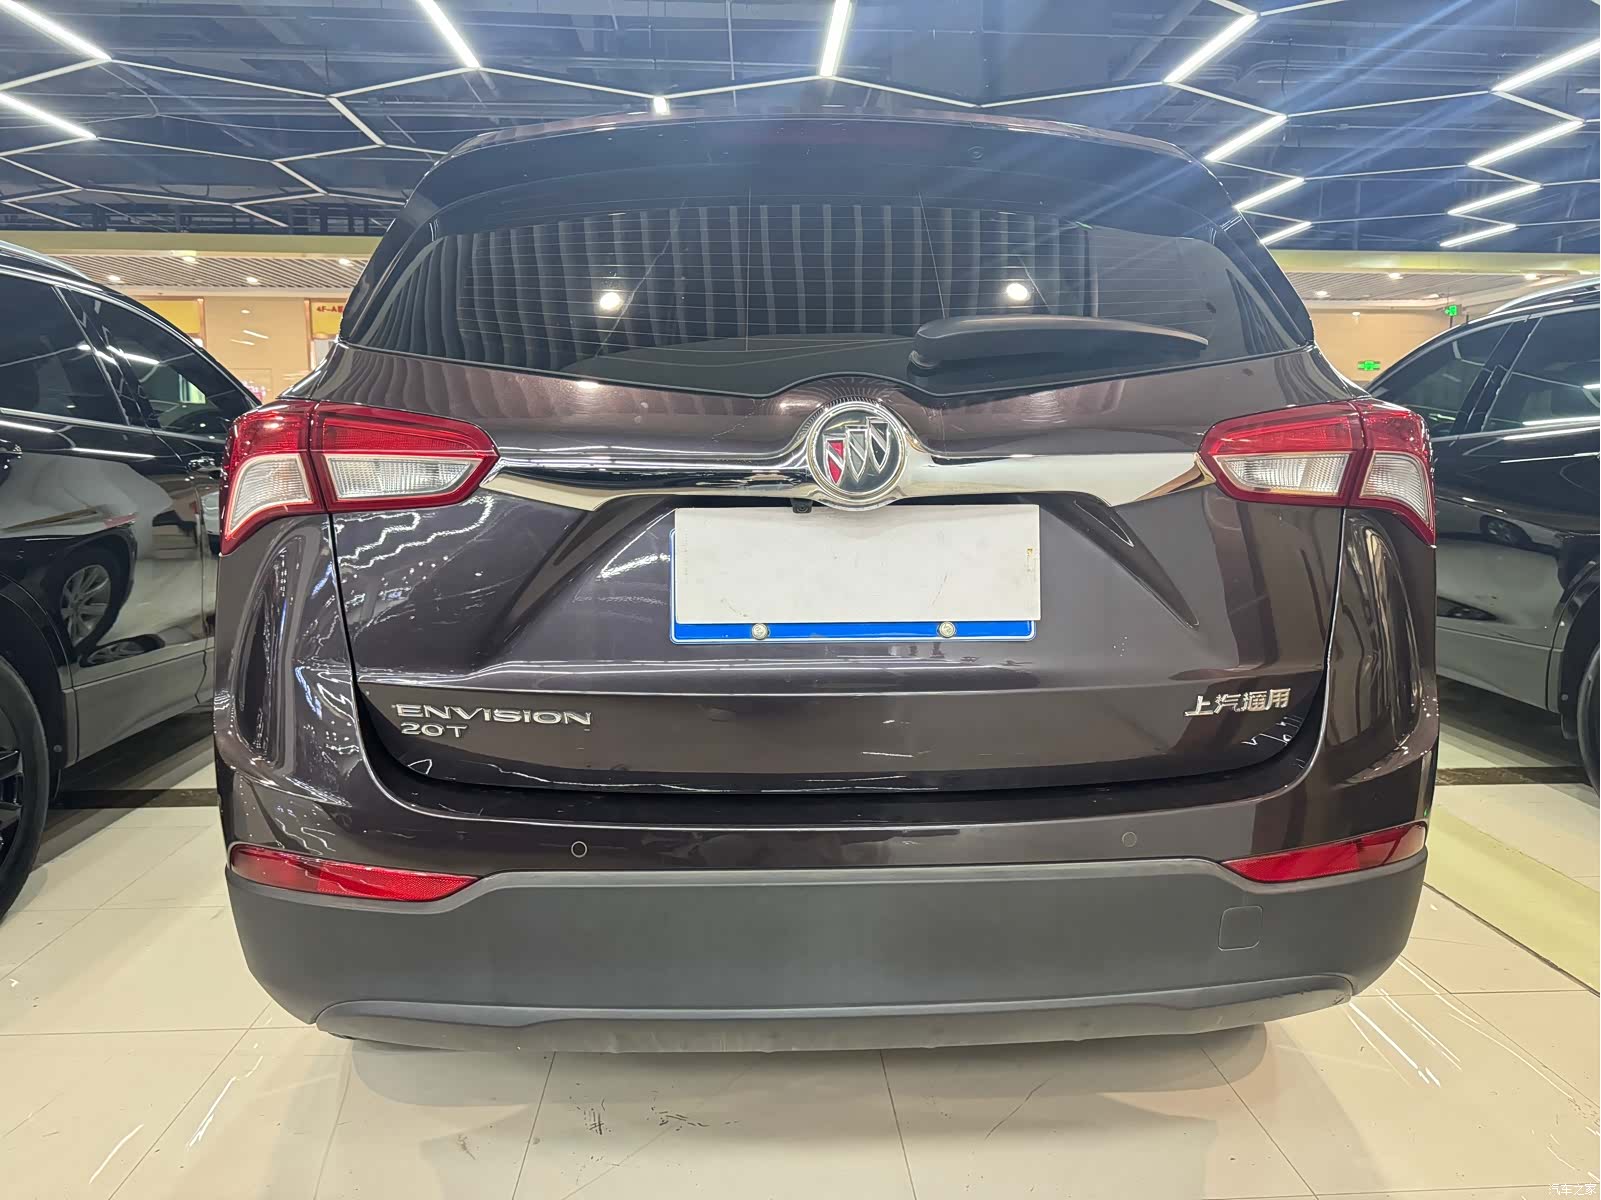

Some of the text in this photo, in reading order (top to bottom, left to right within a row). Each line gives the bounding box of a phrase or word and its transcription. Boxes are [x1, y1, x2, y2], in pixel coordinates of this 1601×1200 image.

[1184, 687, 1291, 717] 上汽通用
[395, 703, 592, 725] ENVISION
[400, 722, 468, 738] 20T
